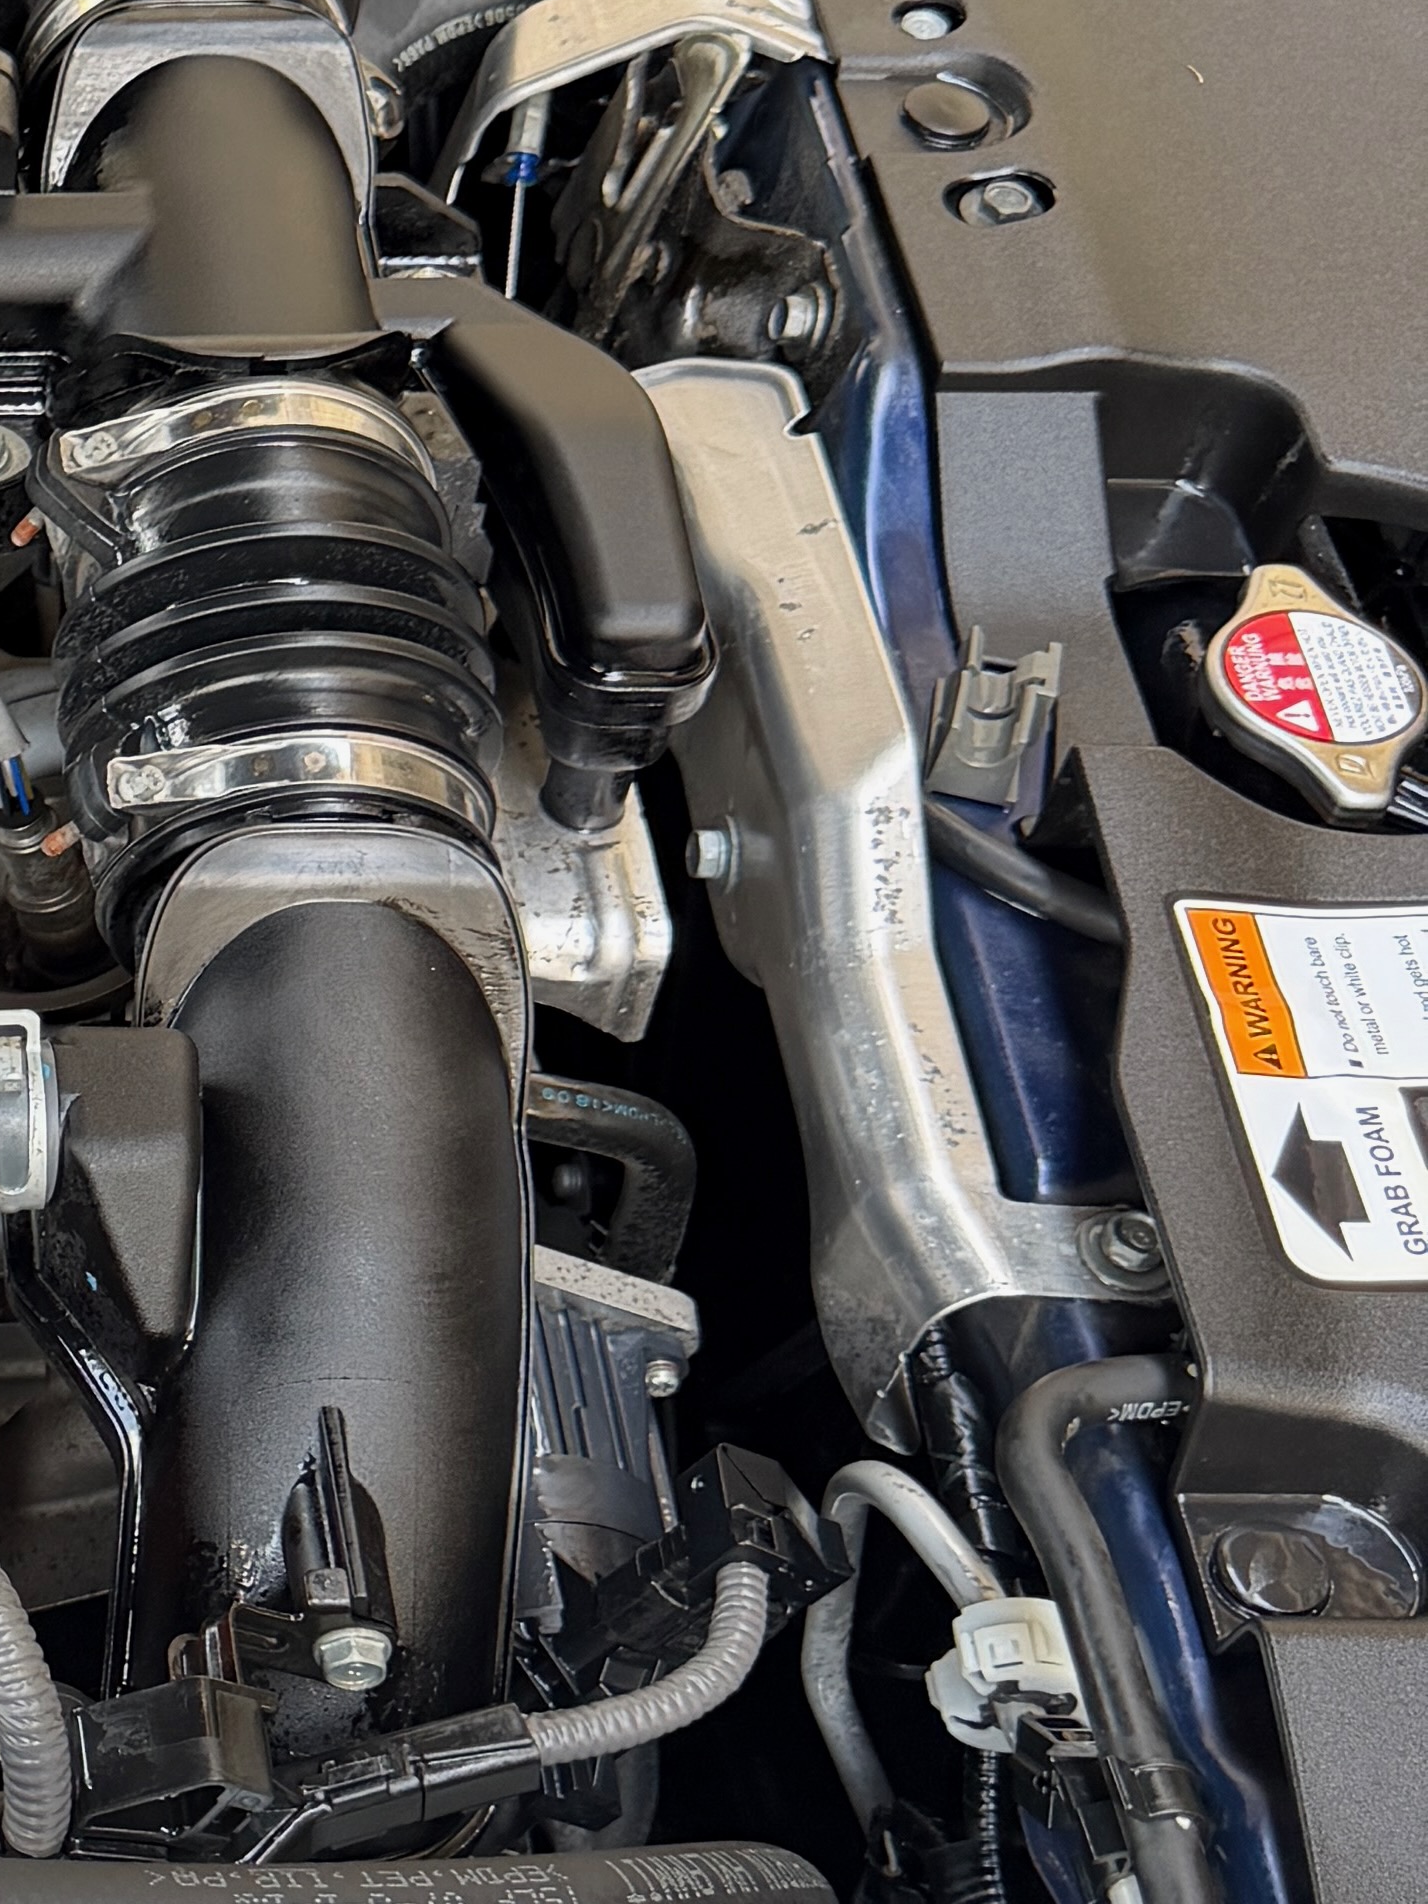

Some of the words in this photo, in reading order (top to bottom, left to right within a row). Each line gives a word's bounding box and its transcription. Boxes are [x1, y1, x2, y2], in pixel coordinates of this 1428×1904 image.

[1304, 936, 1326, 966] bare
[1392, 934, 1415, 955] hot
[1212, 917, 1271, 1039] WARNING
[1315, 974, 1341, 1006] touch
[1346, 962, 1367, 997] white
[1330, 1009, 1350, 1031] not
[1343, 1033, 1360, 1053] Do
[1367, 1019, 1390, 1056] metal
[1356, 1106, 1396, 1177] FOAM
[1385, 1184, 1427, 1256] GRAB
